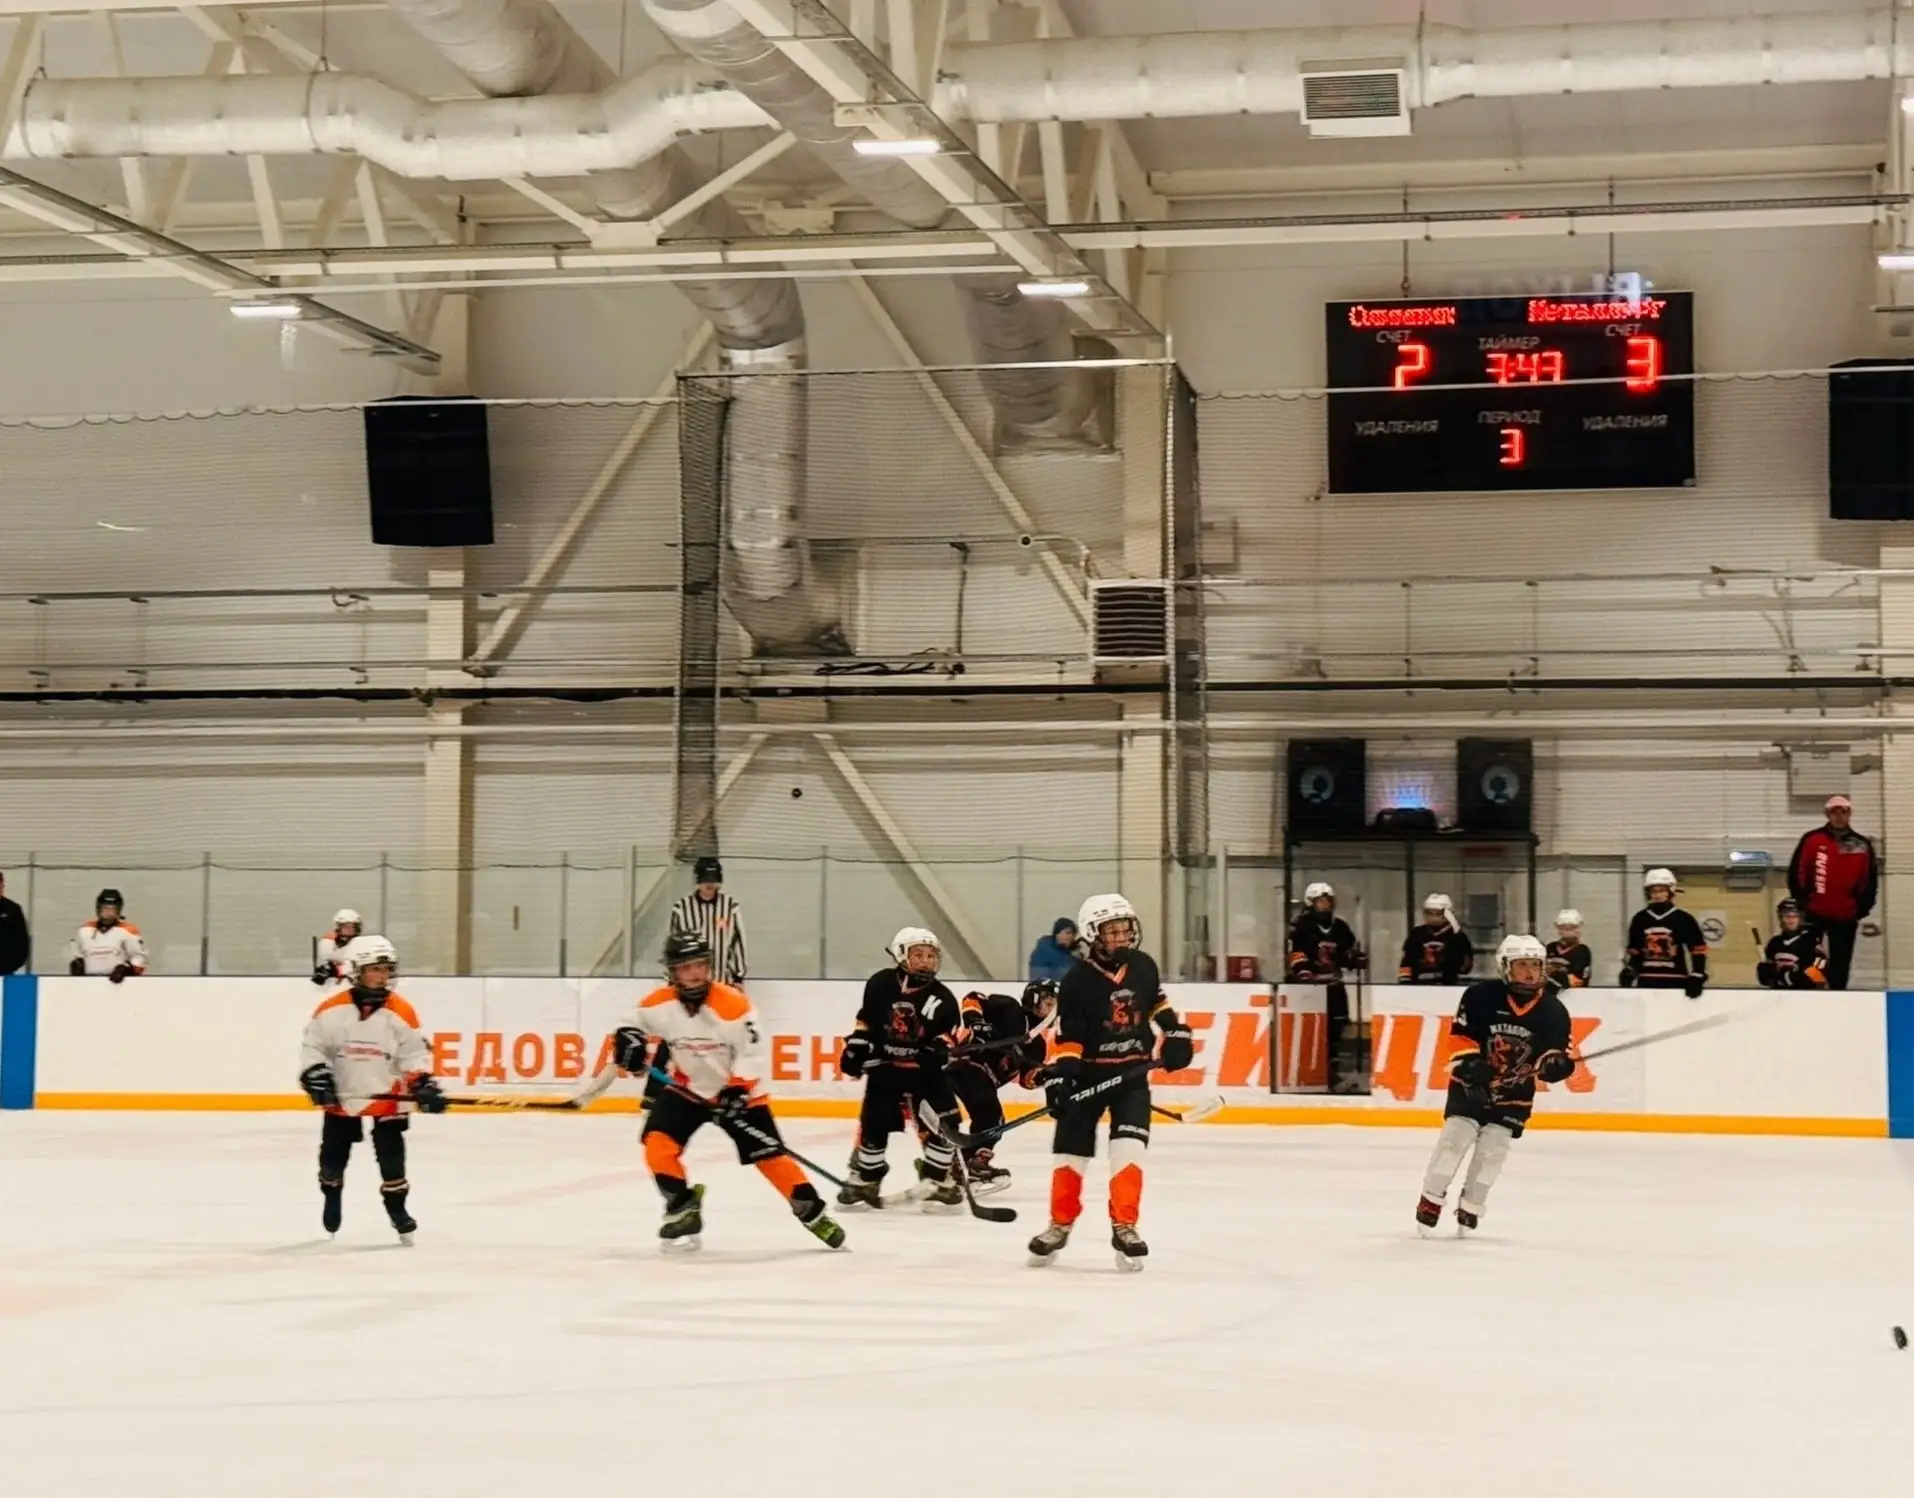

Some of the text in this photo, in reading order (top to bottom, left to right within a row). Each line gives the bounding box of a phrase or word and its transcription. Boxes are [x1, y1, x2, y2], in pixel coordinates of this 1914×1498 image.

[1394, 344, 1428, 390] 2
[1626, 336, 1658, 388] 3
[1354, 419, 1439, 436] УДАЛЕНИЯ
[1477, 410, 1541, 425] ПЕРИОД
[1583, 413, 1668, 431] УДАЛЕНИЯ
[1500, 428, 1523, 464] 3
